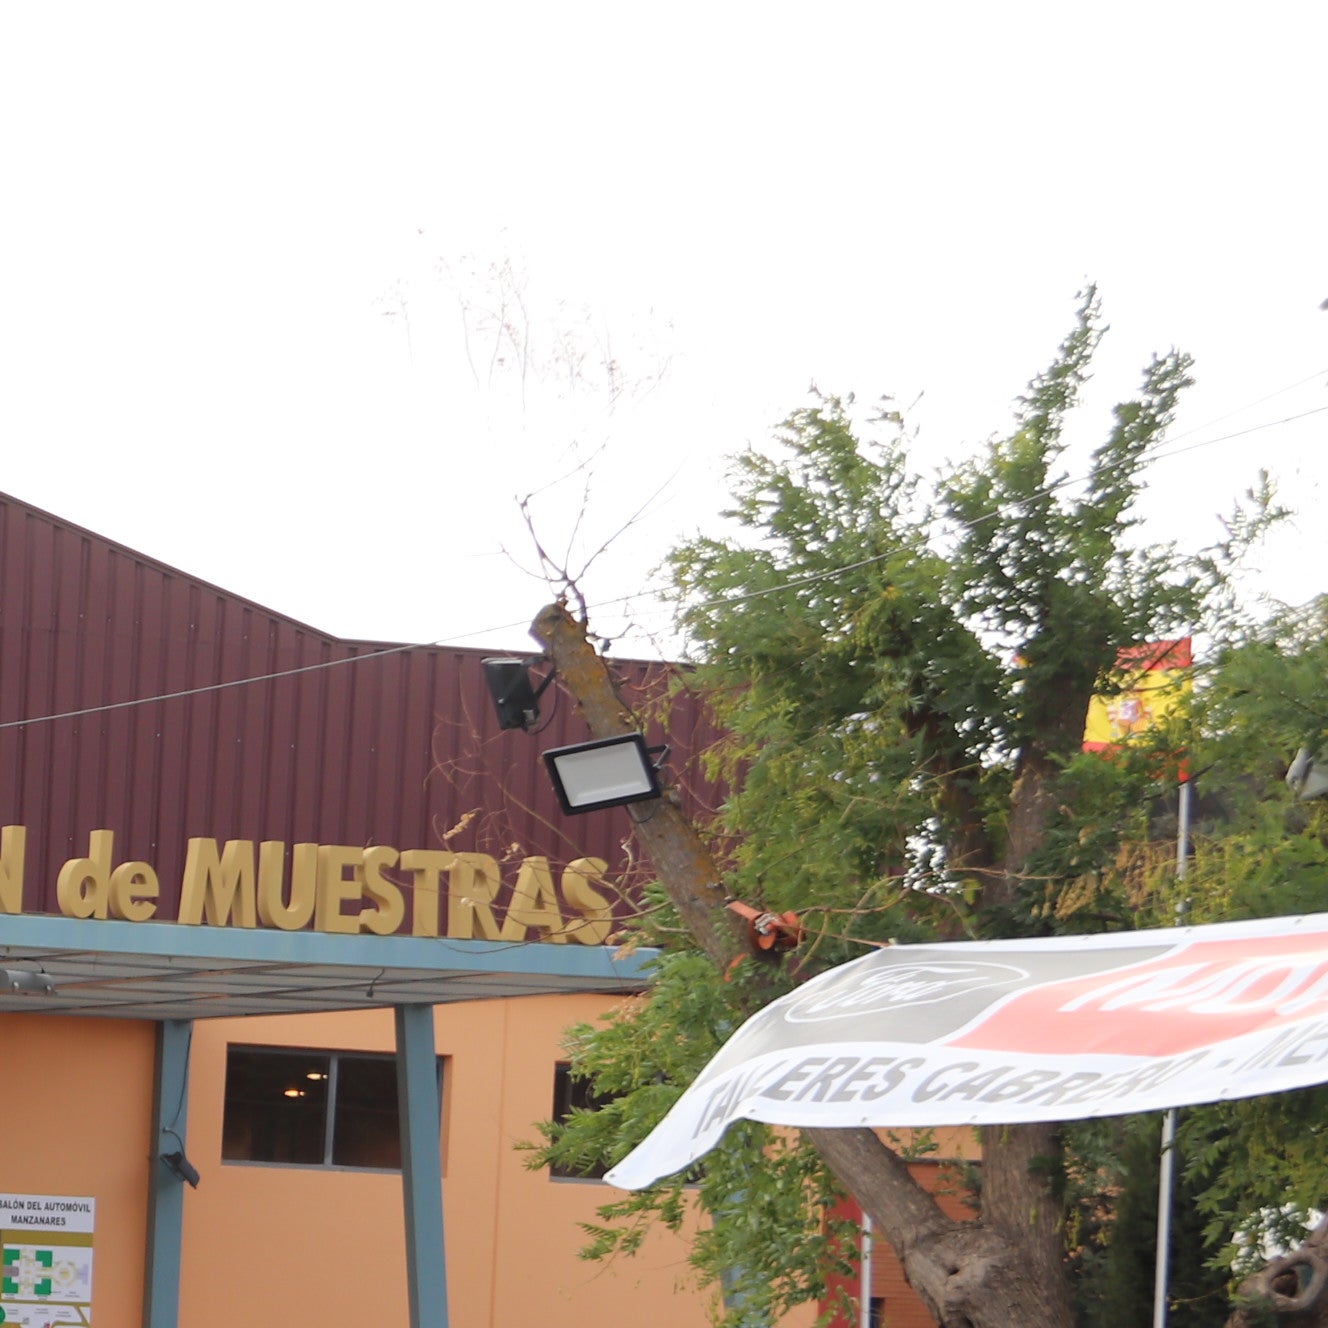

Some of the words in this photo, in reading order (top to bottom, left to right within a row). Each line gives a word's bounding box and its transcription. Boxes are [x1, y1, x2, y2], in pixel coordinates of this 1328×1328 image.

[57, 829, 159, 921] de
[177, 836, 613, 944] MUESTRAS
[27, 1200, 42, 1211] DEL
[44, 1201, 91, 1213] AUTOMÓVIL
[11, 1215, 66, 1226] MANZANARES
